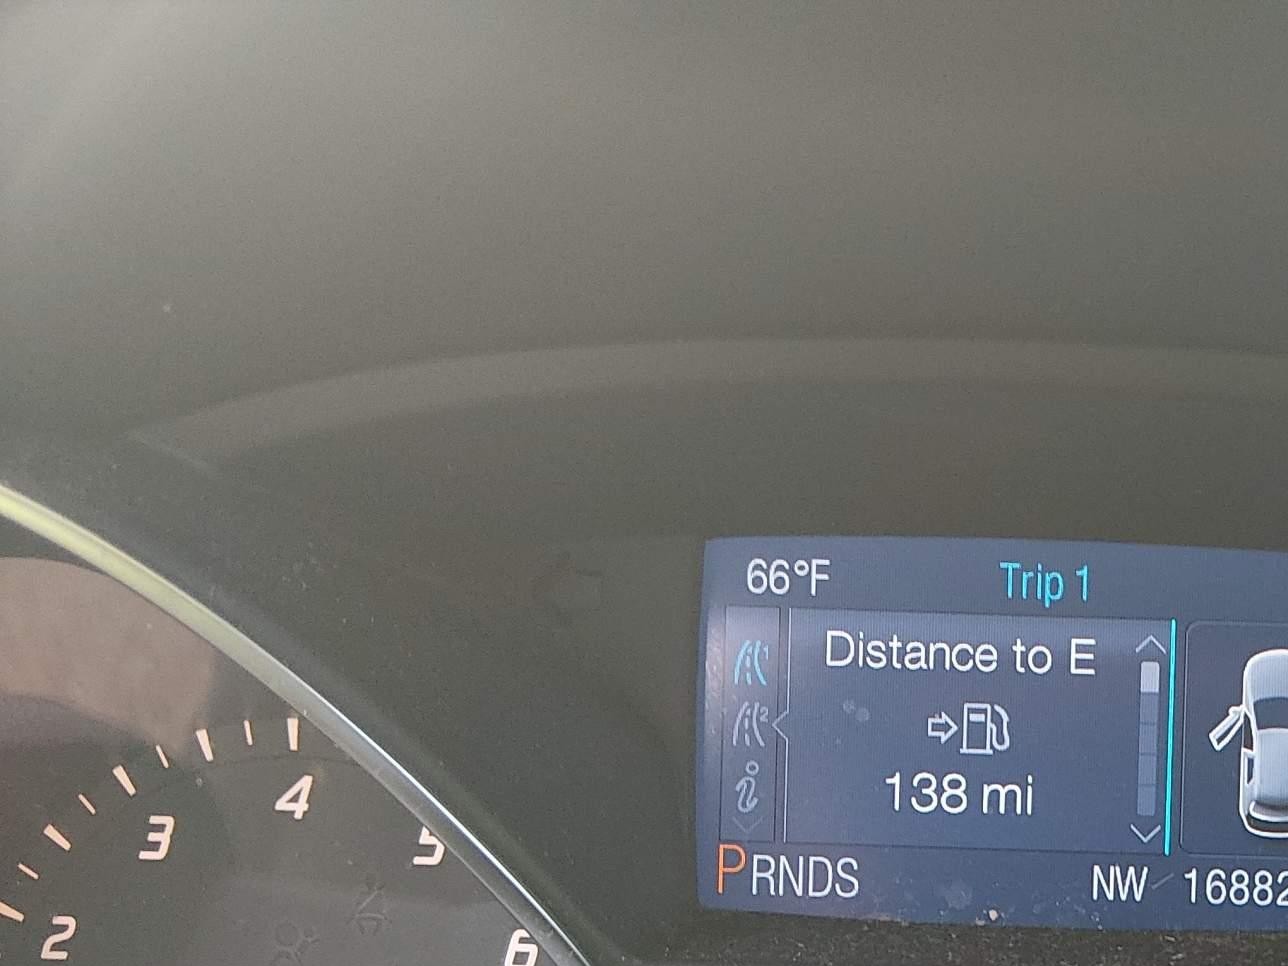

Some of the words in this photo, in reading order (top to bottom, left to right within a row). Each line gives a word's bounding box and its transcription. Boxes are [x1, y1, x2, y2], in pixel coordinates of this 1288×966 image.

[747, 558, 830, 596] 66°F
[1000, 562, 1064, 607] Trip
[1075, 565, 1089, 600] 1
[825, 631, 998, 671] Distance
[1013, 638, 1052, 673] to
[1070, 639, 1096, 675] E
[275, 775, 312, 819] 4
[886, 774, 967, 813] 138
[983, 775, 1032, 815] mi
[139, 816, 174, 860] 3
[413, 827, 444, 866] 5
[1092, 866, 1147, 902] NW
[41, 917, 75, 960] 2
